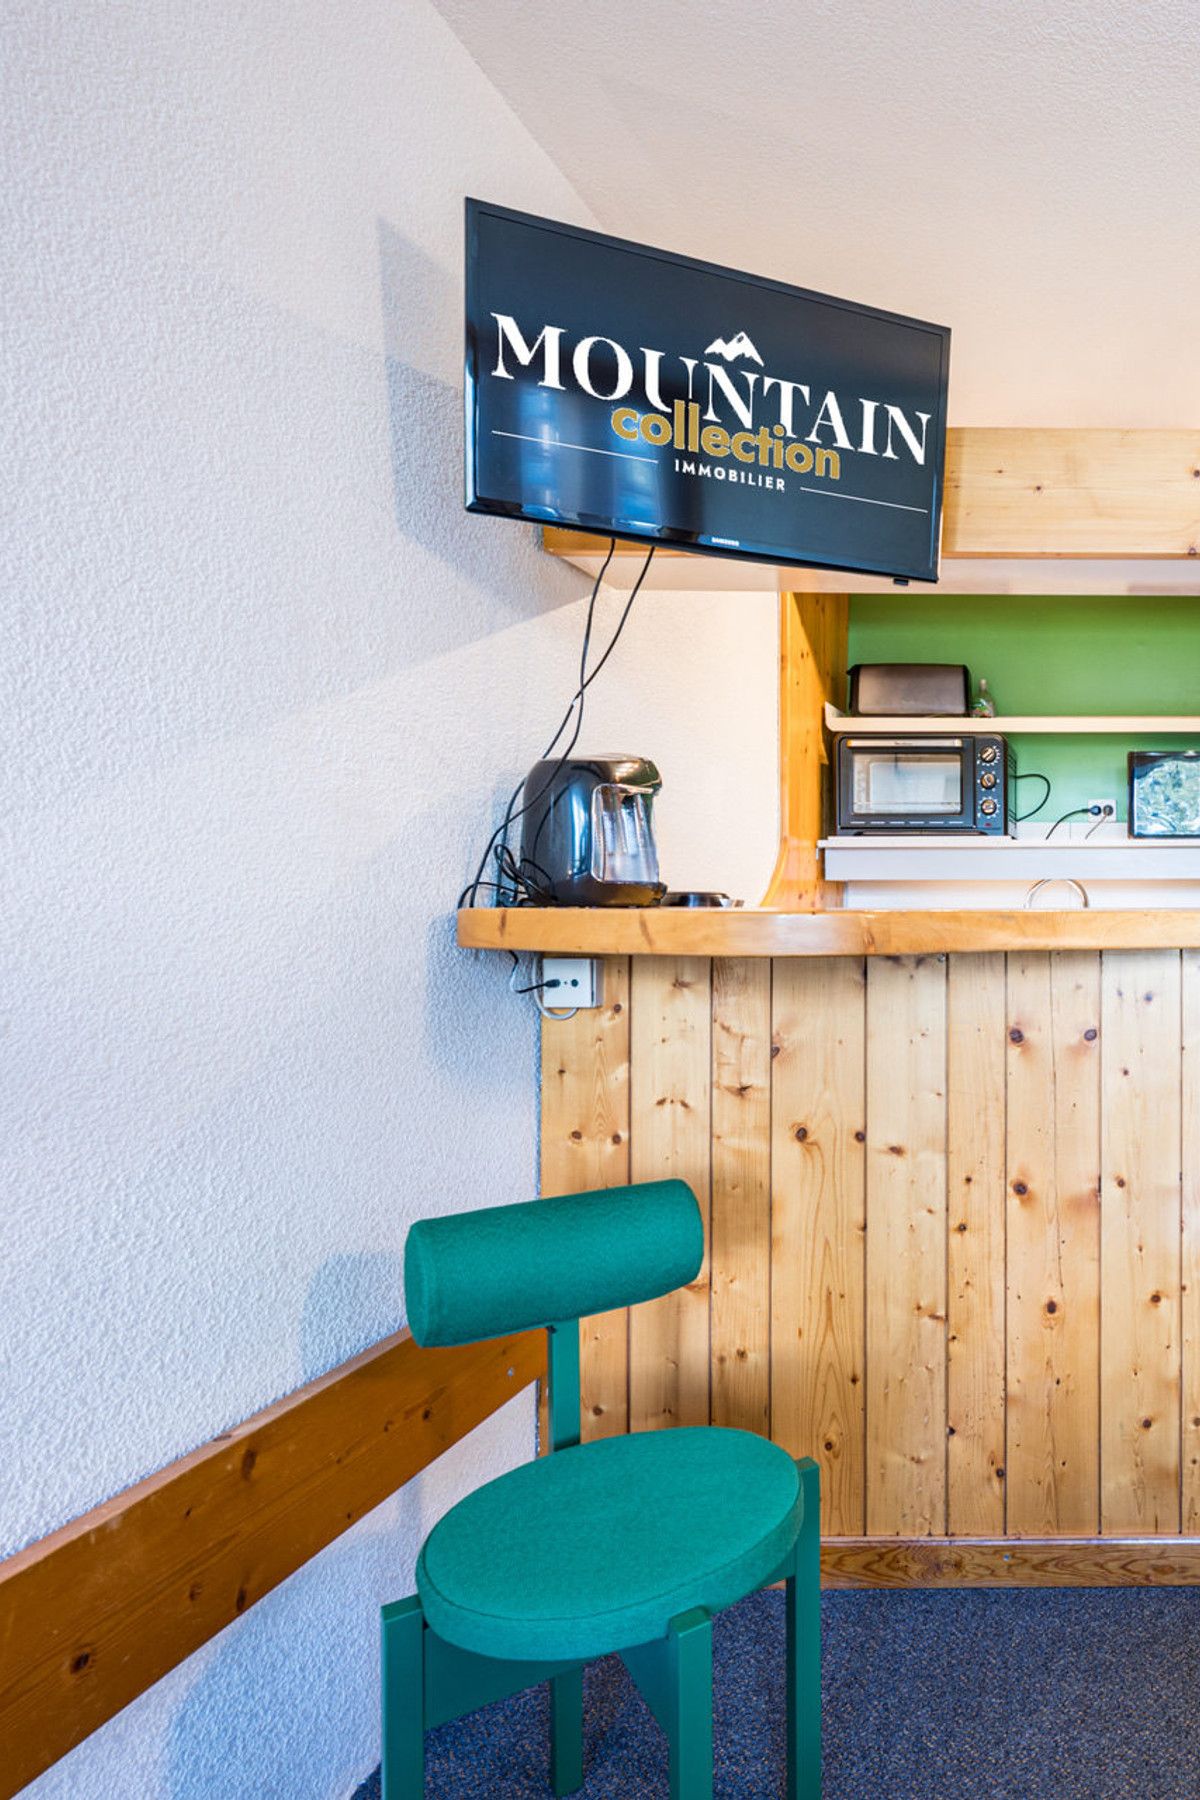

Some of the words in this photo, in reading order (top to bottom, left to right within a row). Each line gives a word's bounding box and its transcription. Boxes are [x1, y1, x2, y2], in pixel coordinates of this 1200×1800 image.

[490, 312, 932, 465] MOUNTAIN
[611, 399, 841, 480] collection
[675, 459, 786, 491] IMMOBILIER
